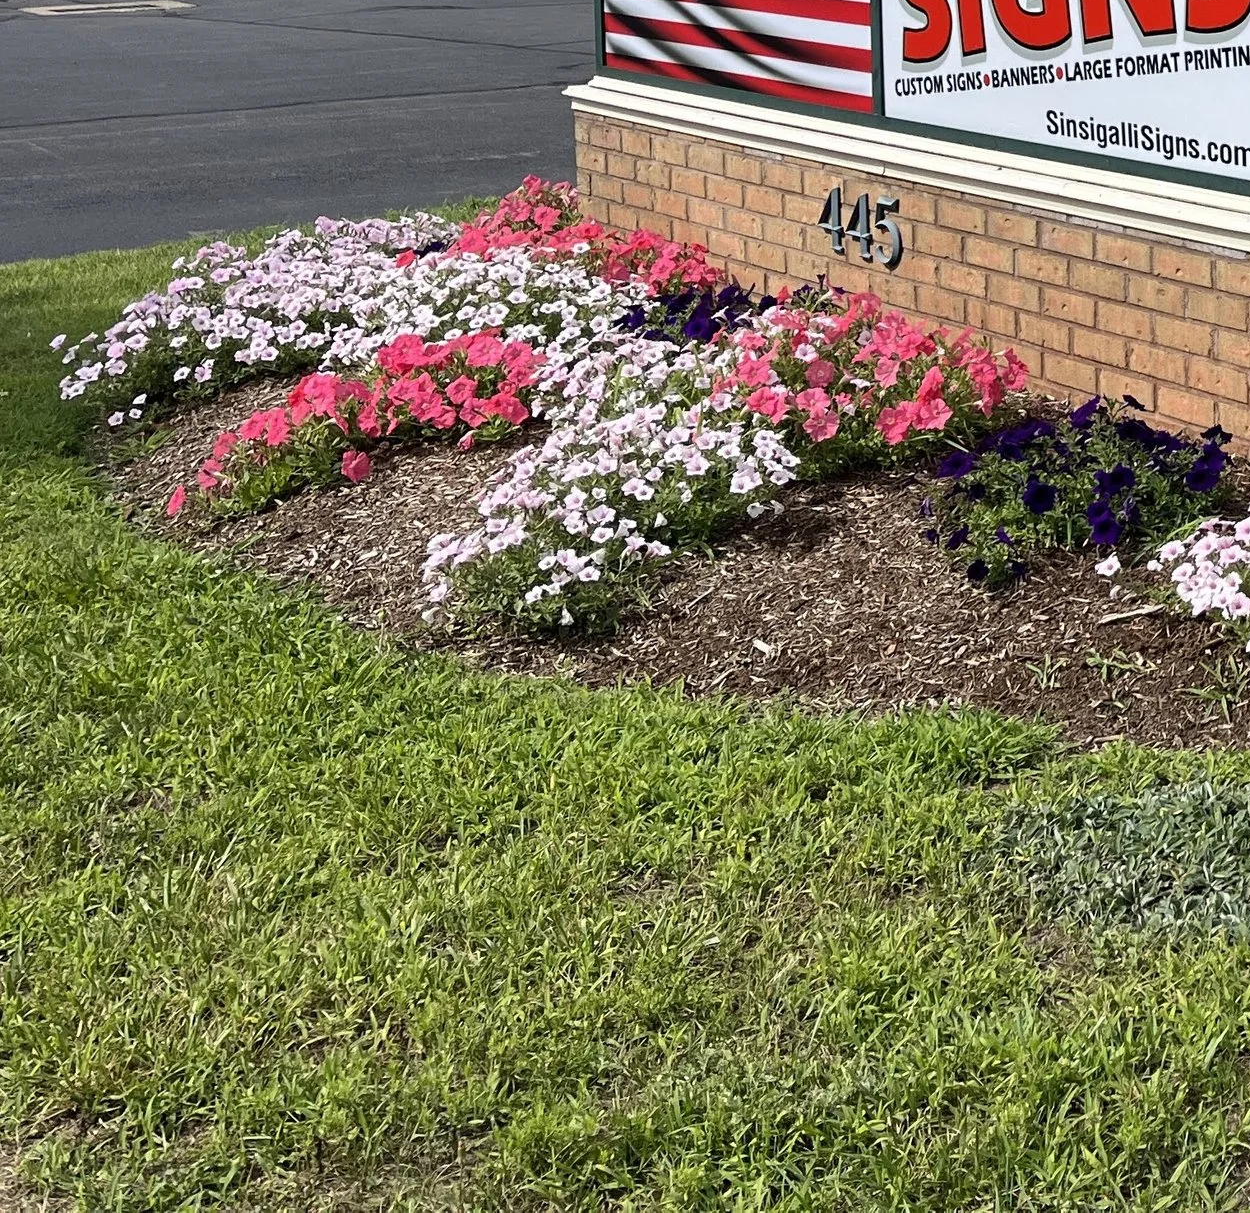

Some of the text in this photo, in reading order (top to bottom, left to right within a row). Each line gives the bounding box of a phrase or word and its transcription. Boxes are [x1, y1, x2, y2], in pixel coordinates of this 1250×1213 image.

[895, 75, 944, 96] CUSTOM
[946, 71, 984, 93] SIGNS
[992, 67, 1055, 88] BANNERS
[1065, 61, 1112, 82] LARGE
[1116, 55, 1180, 77] FORMAT
[818, 187, 904, 271] 445
